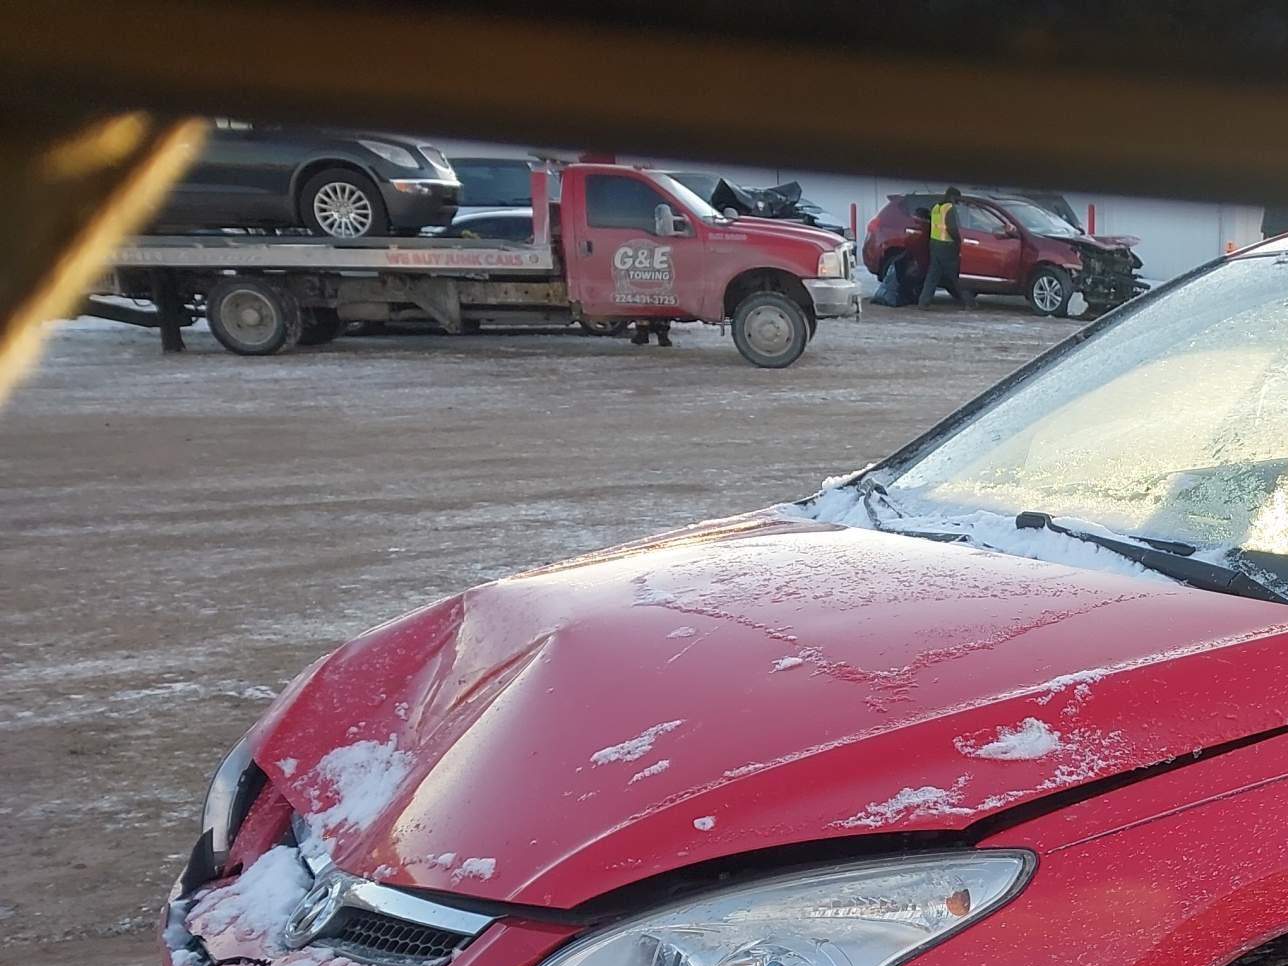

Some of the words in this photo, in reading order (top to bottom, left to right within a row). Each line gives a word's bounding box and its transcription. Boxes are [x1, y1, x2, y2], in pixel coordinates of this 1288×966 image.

[385, 253, 409, 266] WE
[410, 253, 443, 266] BUY
[446, 254, 482, 266] JUNK
[484, 254, 523, 267] CARS
[614, 246, 671, 269] G&E
[629, 270, 670, 281] TOWING
